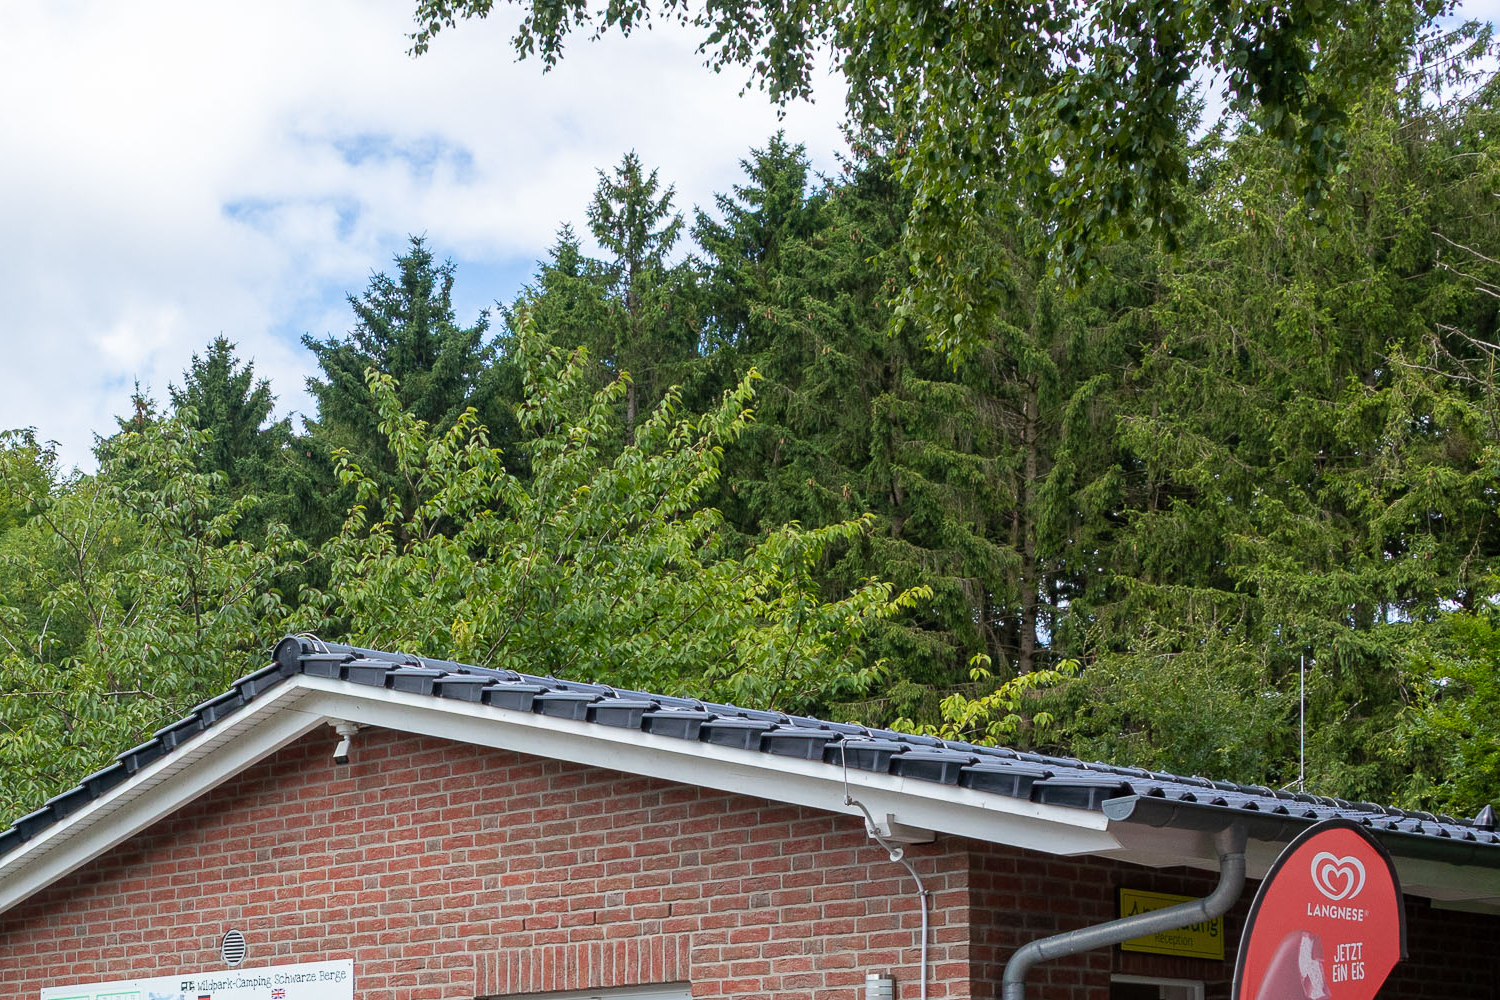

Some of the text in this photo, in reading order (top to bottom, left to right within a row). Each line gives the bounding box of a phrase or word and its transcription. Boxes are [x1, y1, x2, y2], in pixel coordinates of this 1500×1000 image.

[1154, 934, 1194, 948] Reception
[1333, 942, 1363, 963] JETZT
[197, 970, 347, 993] Wildpark-Camping Schwarze Berge
